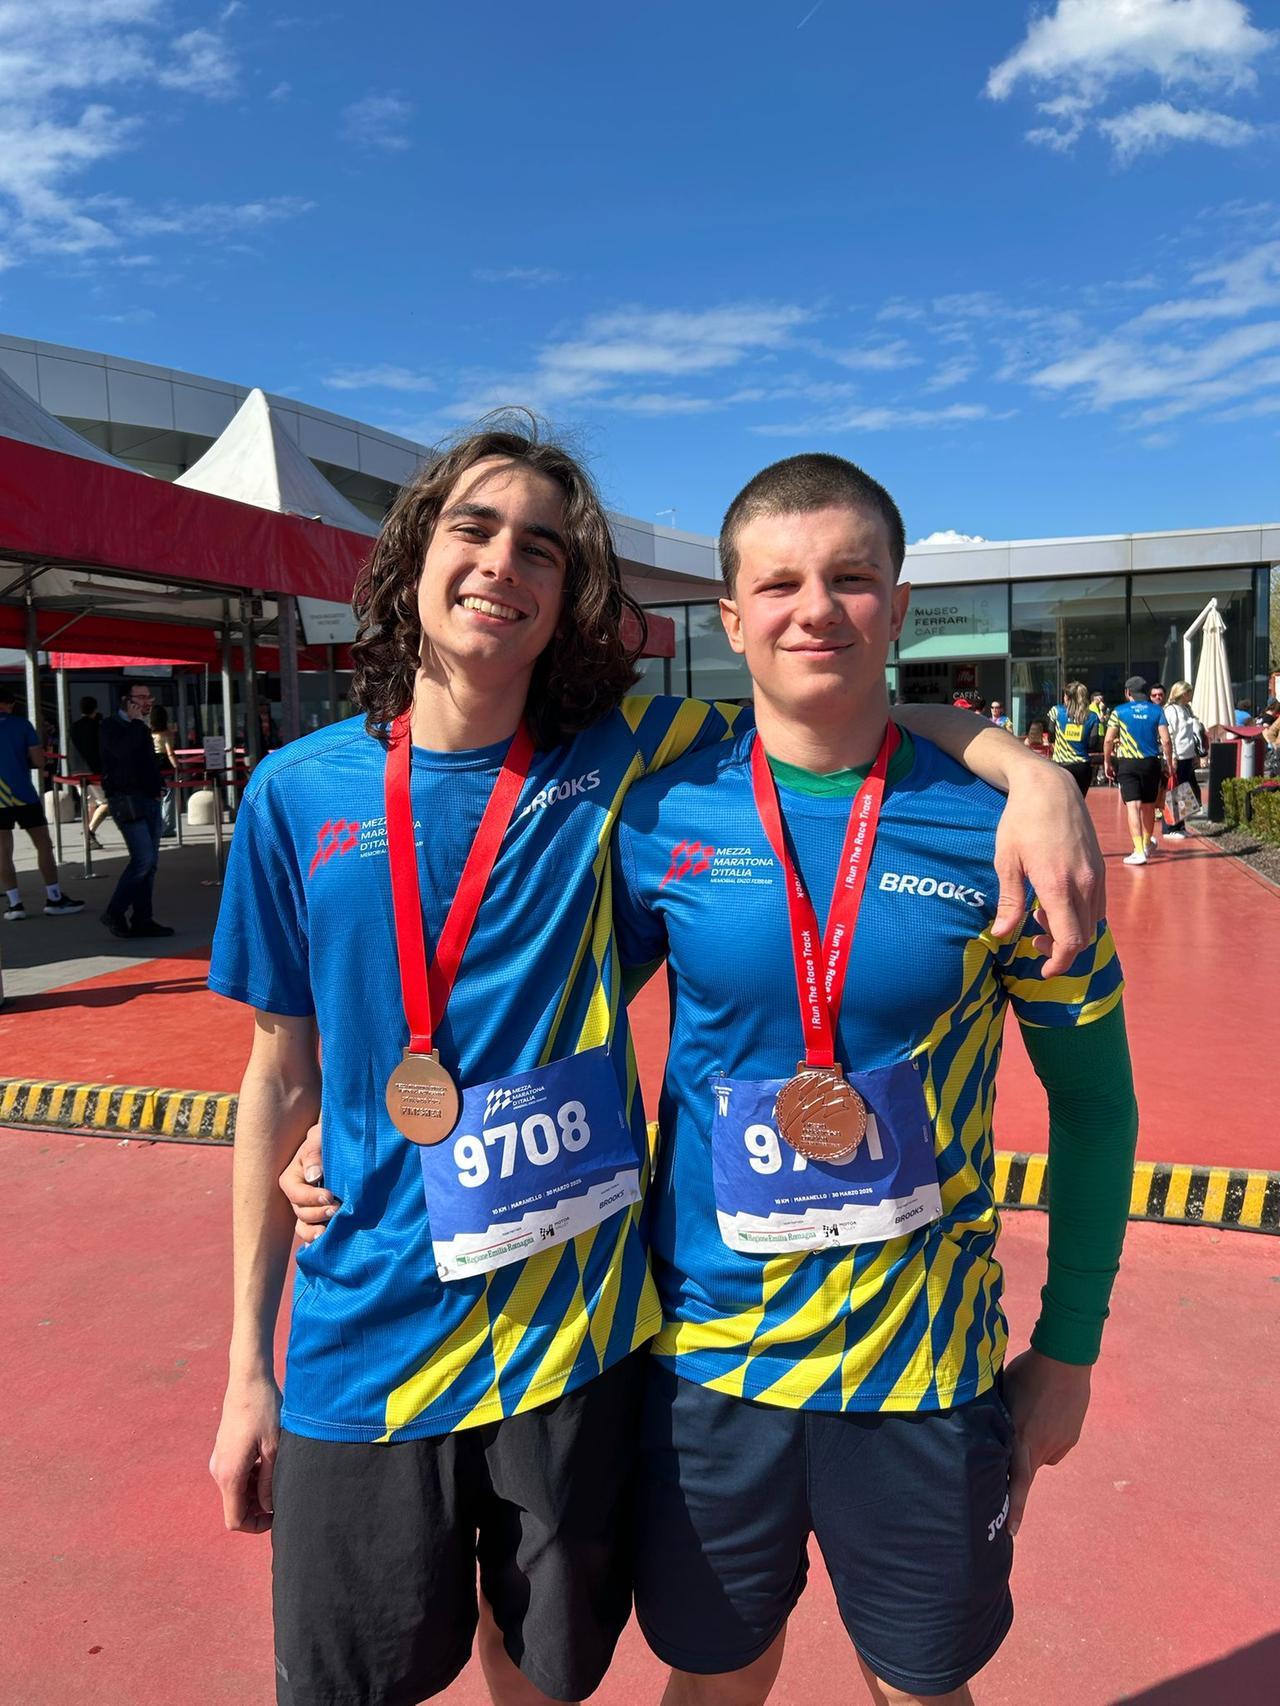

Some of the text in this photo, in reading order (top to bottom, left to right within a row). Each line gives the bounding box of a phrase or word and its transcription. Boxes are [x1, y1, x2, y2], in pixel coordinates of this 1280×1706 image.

[915, 606, 958, 616] MUSEO
[915, 616, 968, 626] FERRARI
[859, 794, 872, 819] Track
[854, 821, 867, 845] Race
[716, 847, 752, 856] MEZZA
[850, 846, 862, 863] The
[713, 858, 774, 867] MARATONA
[710, 868, 752, 877] D'ITALIA
[845, 865, 858, 884] Run
[879, 872, 987, 908] BROOKS
[801, 930, 813, 958] Track
[832, 928, 844, 948] Run
[828, 949, 840, 968] The
[802, 960, 815, 984] Race
[804, 986, 818, 1004] The
[807, 1006, 822, 1025] Run
[512, 1084, 532, 1094] MEZZA
[512, 1086, 545, 1101] MARATONA
[453, 1100, 591, 1188] 9708
[744, 1113, 884, 1175] 91
[511, 1193, 542, 1209] MARANELLO
[553, 1183, 570, 1193] MARZO
[599, 1189, 625, 1209] BROOKS
[793, 1192, 828, 1203] MARANELLO
[839, 1189, 859, 1198] MARZO
[895, 1204, 924, 1225] BROOKS
